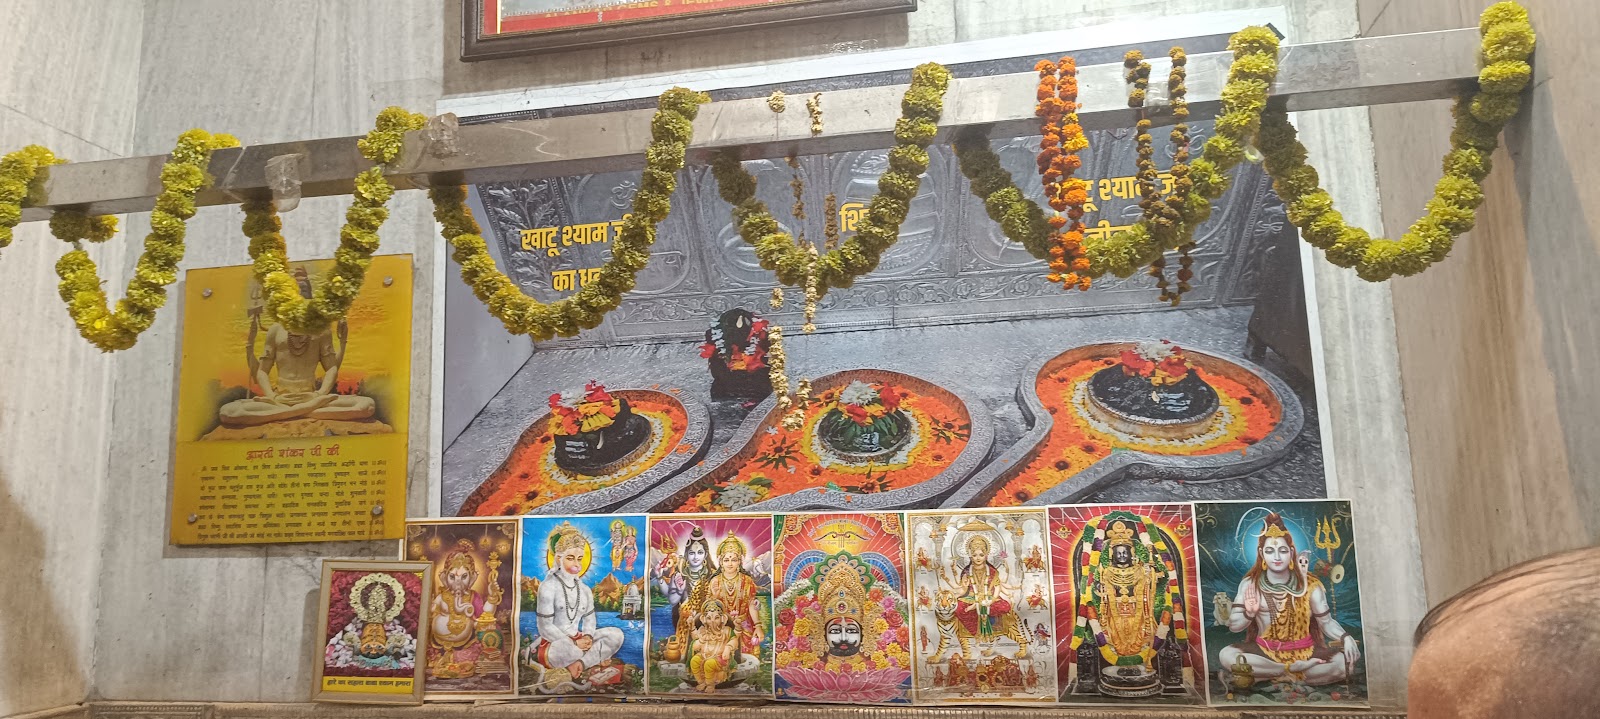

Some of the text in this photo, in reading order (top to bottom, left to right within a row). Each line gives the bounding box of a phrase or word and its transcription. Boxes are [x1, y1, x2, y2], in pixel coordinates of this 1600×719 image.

[520, 227, 560, 257] खाटू
[562, 222, 609, 246] श्याम
[552, 270, 576, 291] का
[246, 443, 340, 460] आरती शंकर जी की
